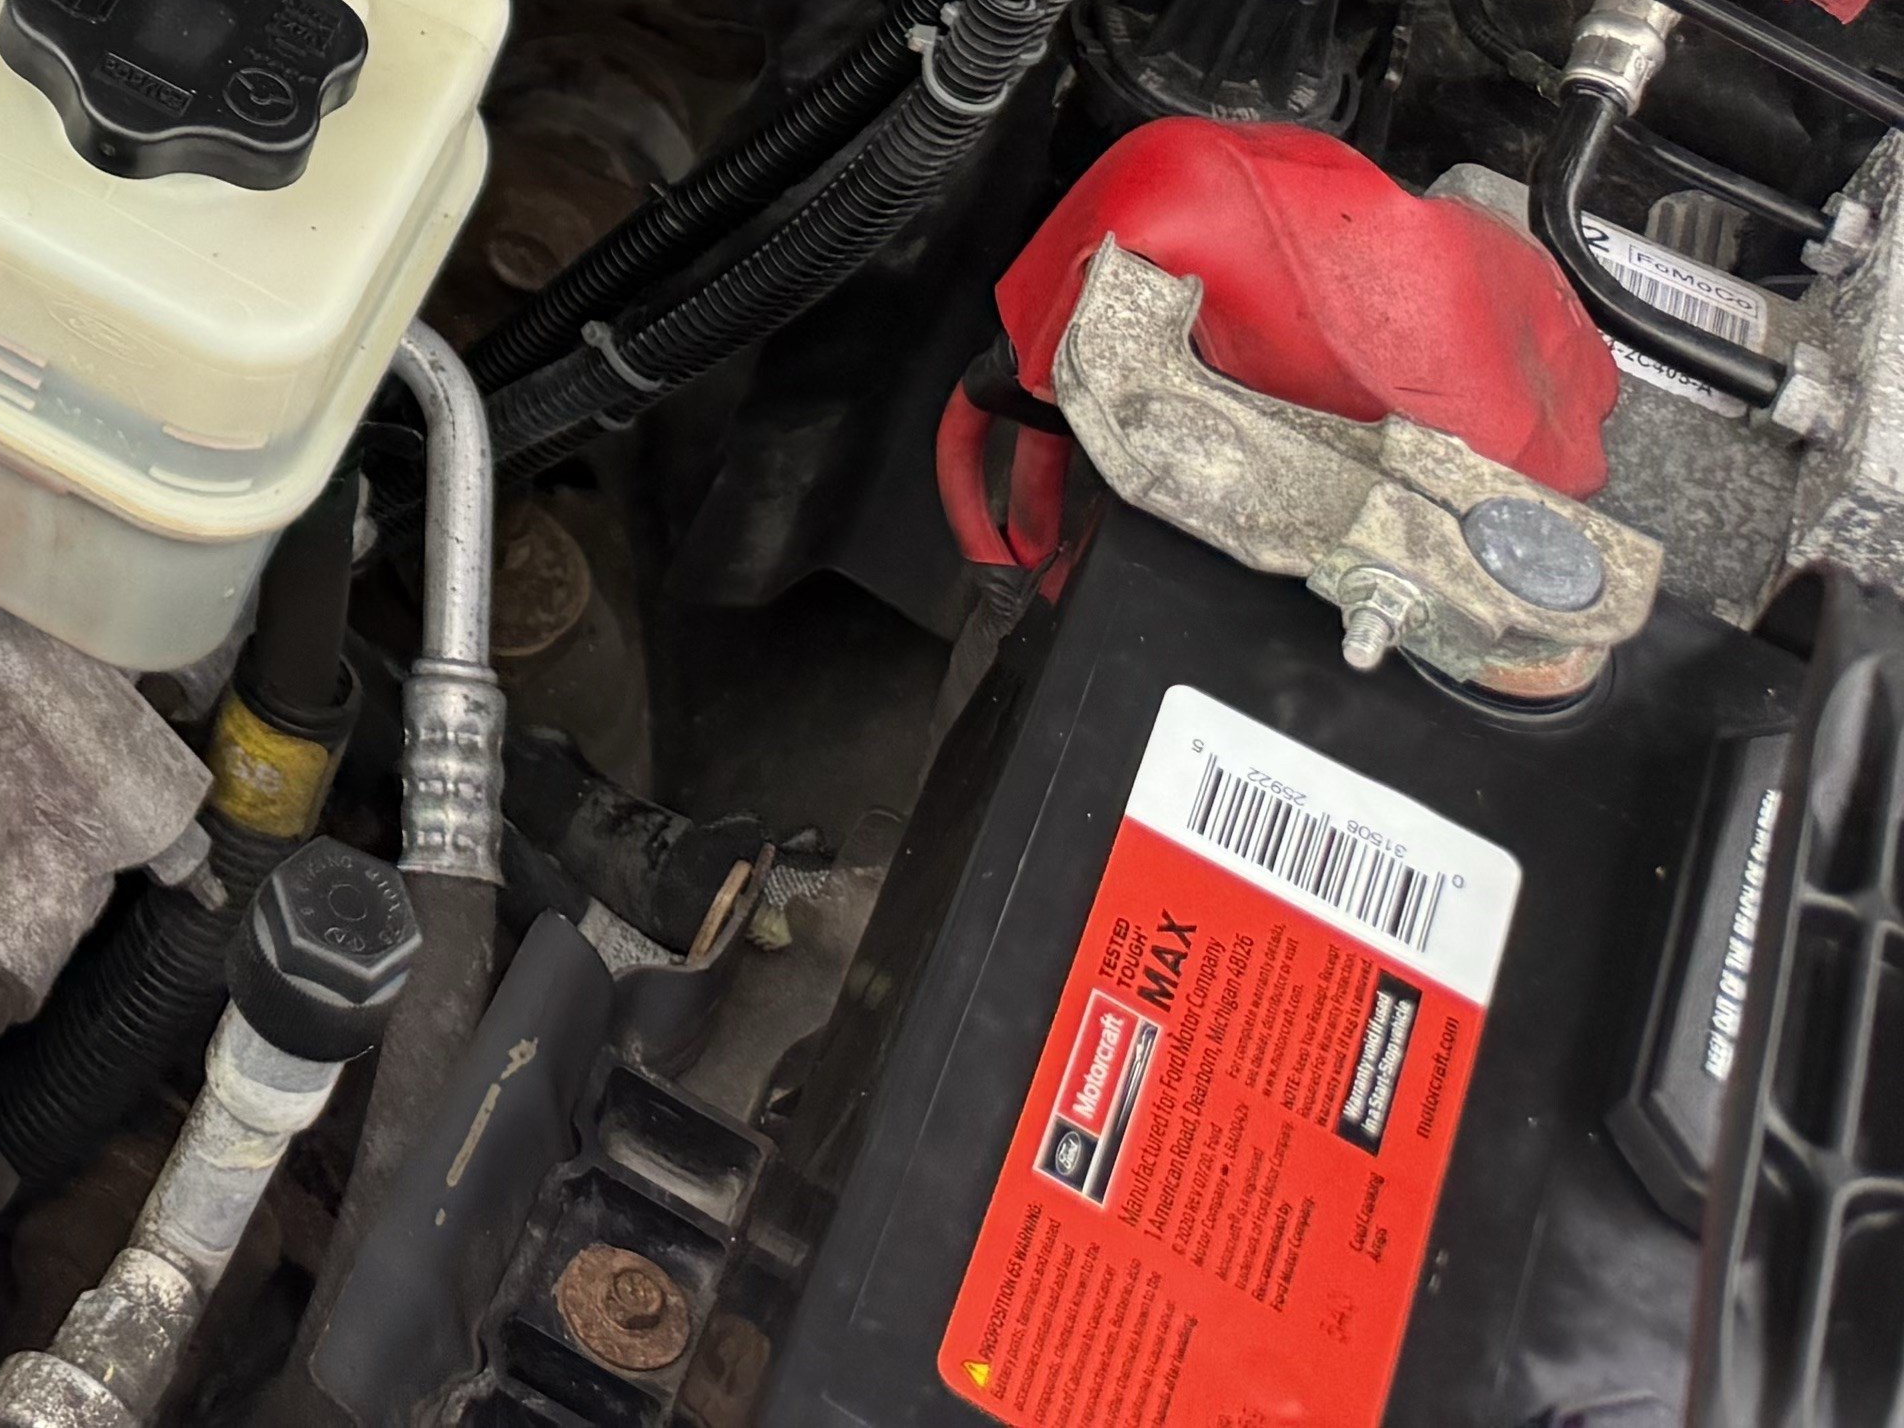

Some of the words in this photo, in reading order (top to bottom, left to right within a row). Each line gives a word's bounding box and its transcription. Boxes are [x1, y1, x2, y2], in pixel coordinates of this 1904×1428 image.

[1636, 252, 1753, 310] FoMoCo
[1190, 736, 1205, 754] 5
[1246, 764, 1307, 807] 25922
[1345, 816, 1407, 860] 31508
[1098, 915, 1131, 981] TESTED
[1135, 908, 1197, 1013] MAX
[1184, 933, 1227, 1012] Company
[1224, 930, 1256, 981] 48126
[1166, 1002, 1202, 1057] Motor
[1204, 974, 1244, 1047] Michigan
[1366, 1017, 1386, 1036] if
[1369, 989, 1394, 1027] used
[1386, 997, 1414, 1047] vehicle
[1070, 1009, 1125, 1122] Motorcraft
[1157, 1050, 1188, 1092] Ford
[1358, 1027, 1383, 1065] void
[1151, 1086, 1178, 1117] for
[1181, 1040, 1223, 1118] Dearborn,
[1342, 1055, 1376, 1123] Warranty
[1367, 1039, 1402, 1113] Start-Stop
[1413, 1013, 1461, 1141] motorcraft.com
[1168, 1111, 1201, 1162] Road,
[1361, 1115, 1380, 1135] in
[1368, 1107, 1382, 1121] a
[1054, 1134, 1081, 1172] Ford
[1116, 1110, 1170, 1229] Manufactured
[1146, 1154, 1186, 1234] American
[1011, 1198, 1043, 1262] WARNING:
[1143, 1228, 1162, 1241] 1
[1004, 1258, 1024, 1280] 65
[977, 1275, 1018, 1362] PROPOSITION
